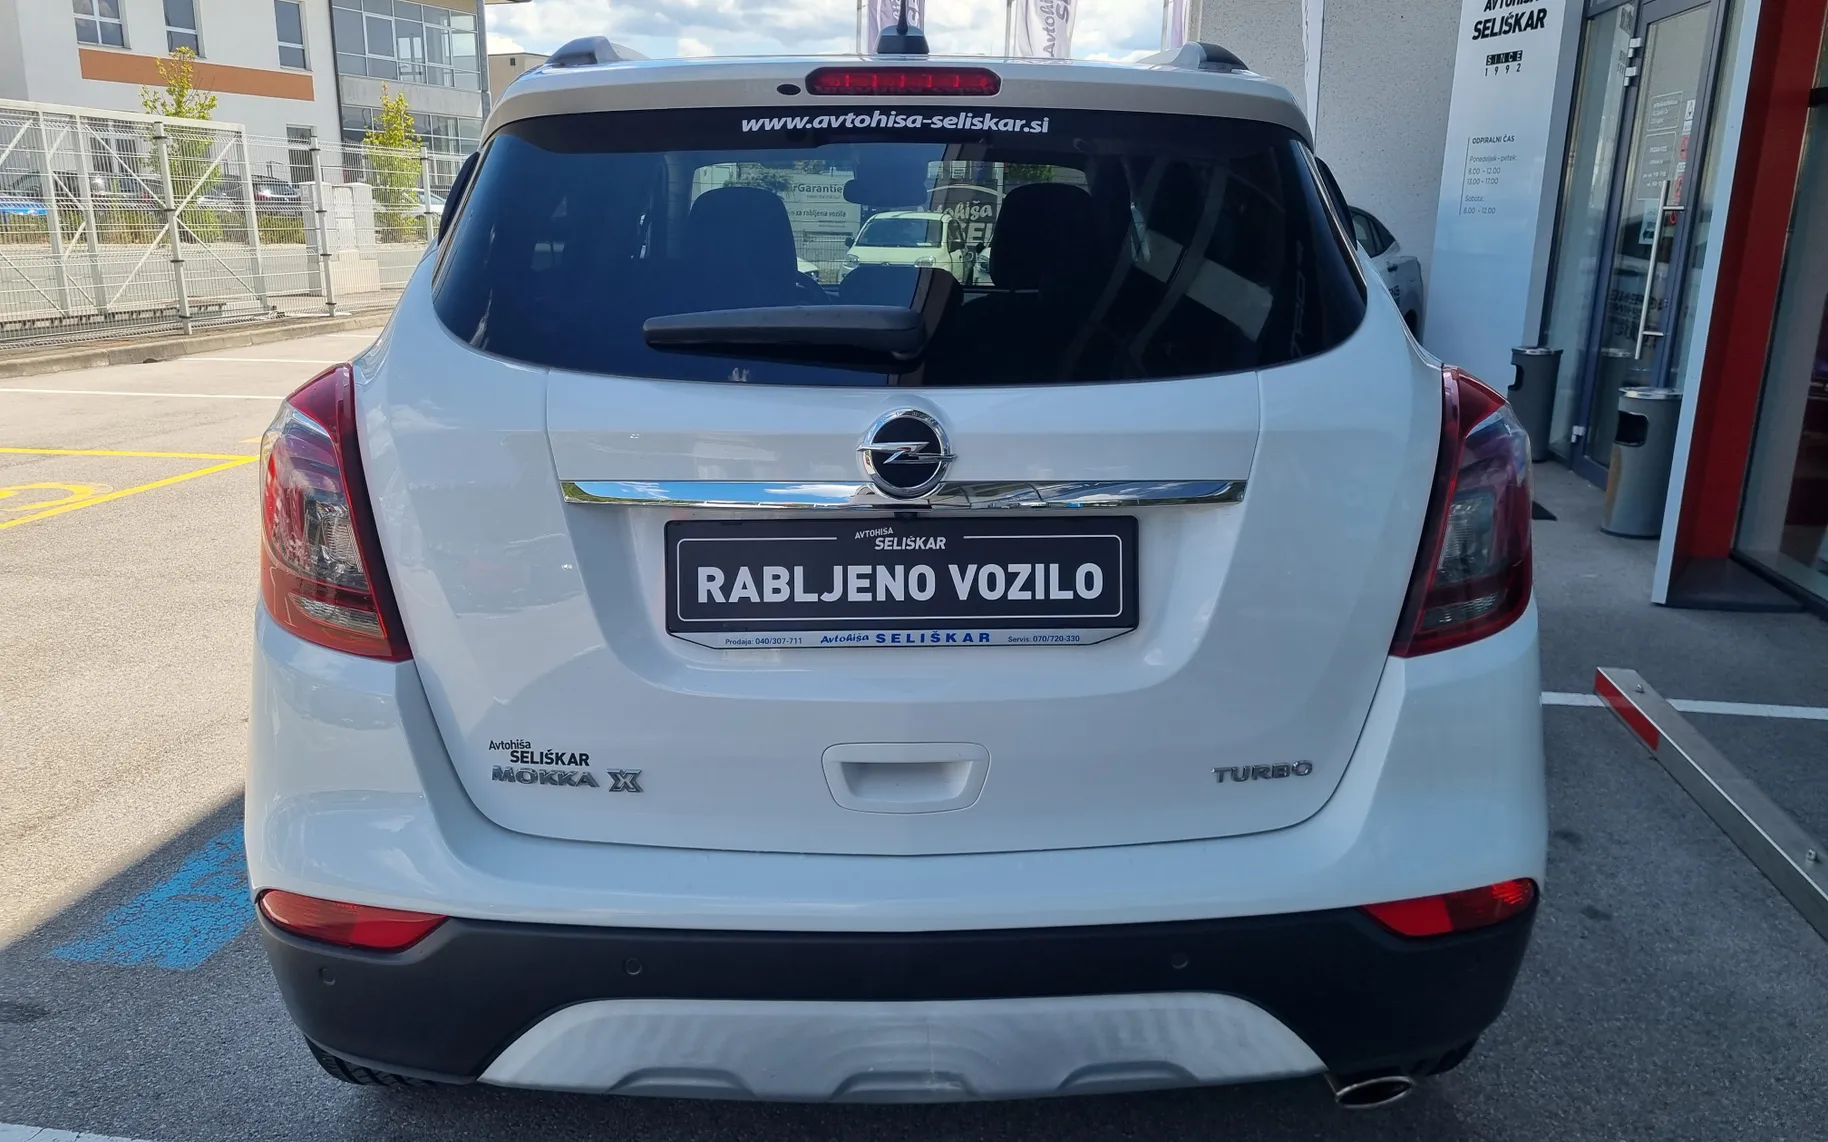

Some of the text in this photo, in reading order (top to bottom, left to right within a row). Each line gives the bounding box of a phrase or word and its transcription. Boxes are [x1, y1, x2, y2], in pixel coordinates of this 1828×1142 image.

[1472, 8, 1547, 40] SELIŠKAR
[1486, 51, 1522, 65] SINCE
[742, 110, 1049, 134] www.avtohisa-seliskar.si
[1472, 134, 1515, 144] ODPIRALNI ČAS
[791, 184, 843, 193] rGarantie
[874, 536, 947, 550] SELIŠKAR
[697, 562, 1104, 603] RABLJENO VOZILO
[755, 637, 802, 645] 040/307-711
[820, 630, 991, 644] Avtohiša SELIŠKAR
[1032, 635, 1080, 643] 070/720-330
[489, 738, 531, 750] Avtohiša
[510, 749, 590, 767] SELIŠKAR
[1211, 760, 1313, 783] TURBO
[492, 765, 644, 793] MOKKA X
